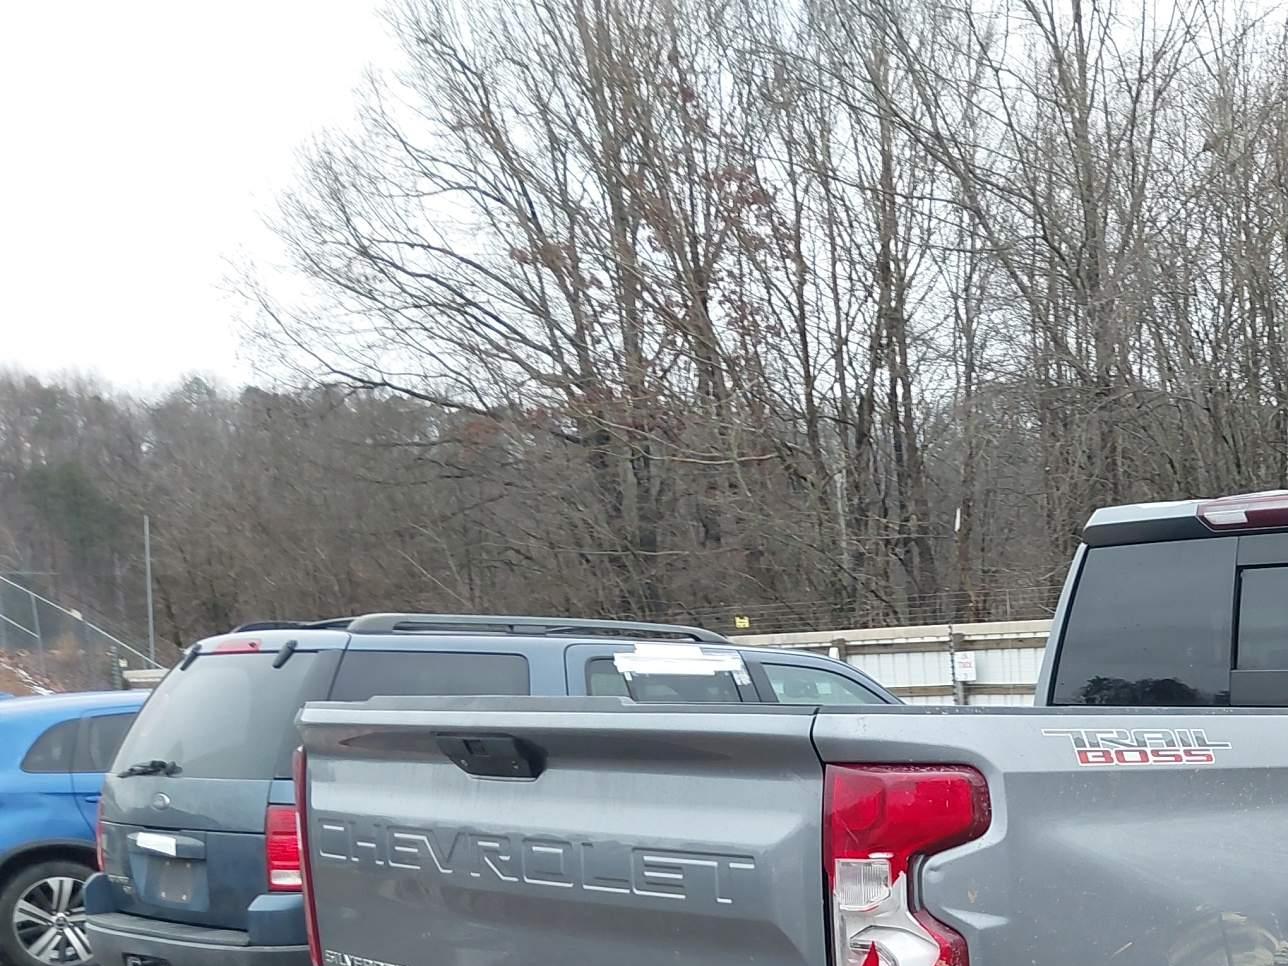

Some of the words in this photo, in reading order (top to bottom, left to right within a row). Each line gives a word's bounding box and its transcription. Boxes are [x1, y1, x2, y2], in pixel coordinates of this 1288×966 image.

[1041, 728, 1233, 750] TRAIL
[1076, 748, 1216, 766] BOSS
[318, 817, 756, 904] CHEVROLET
